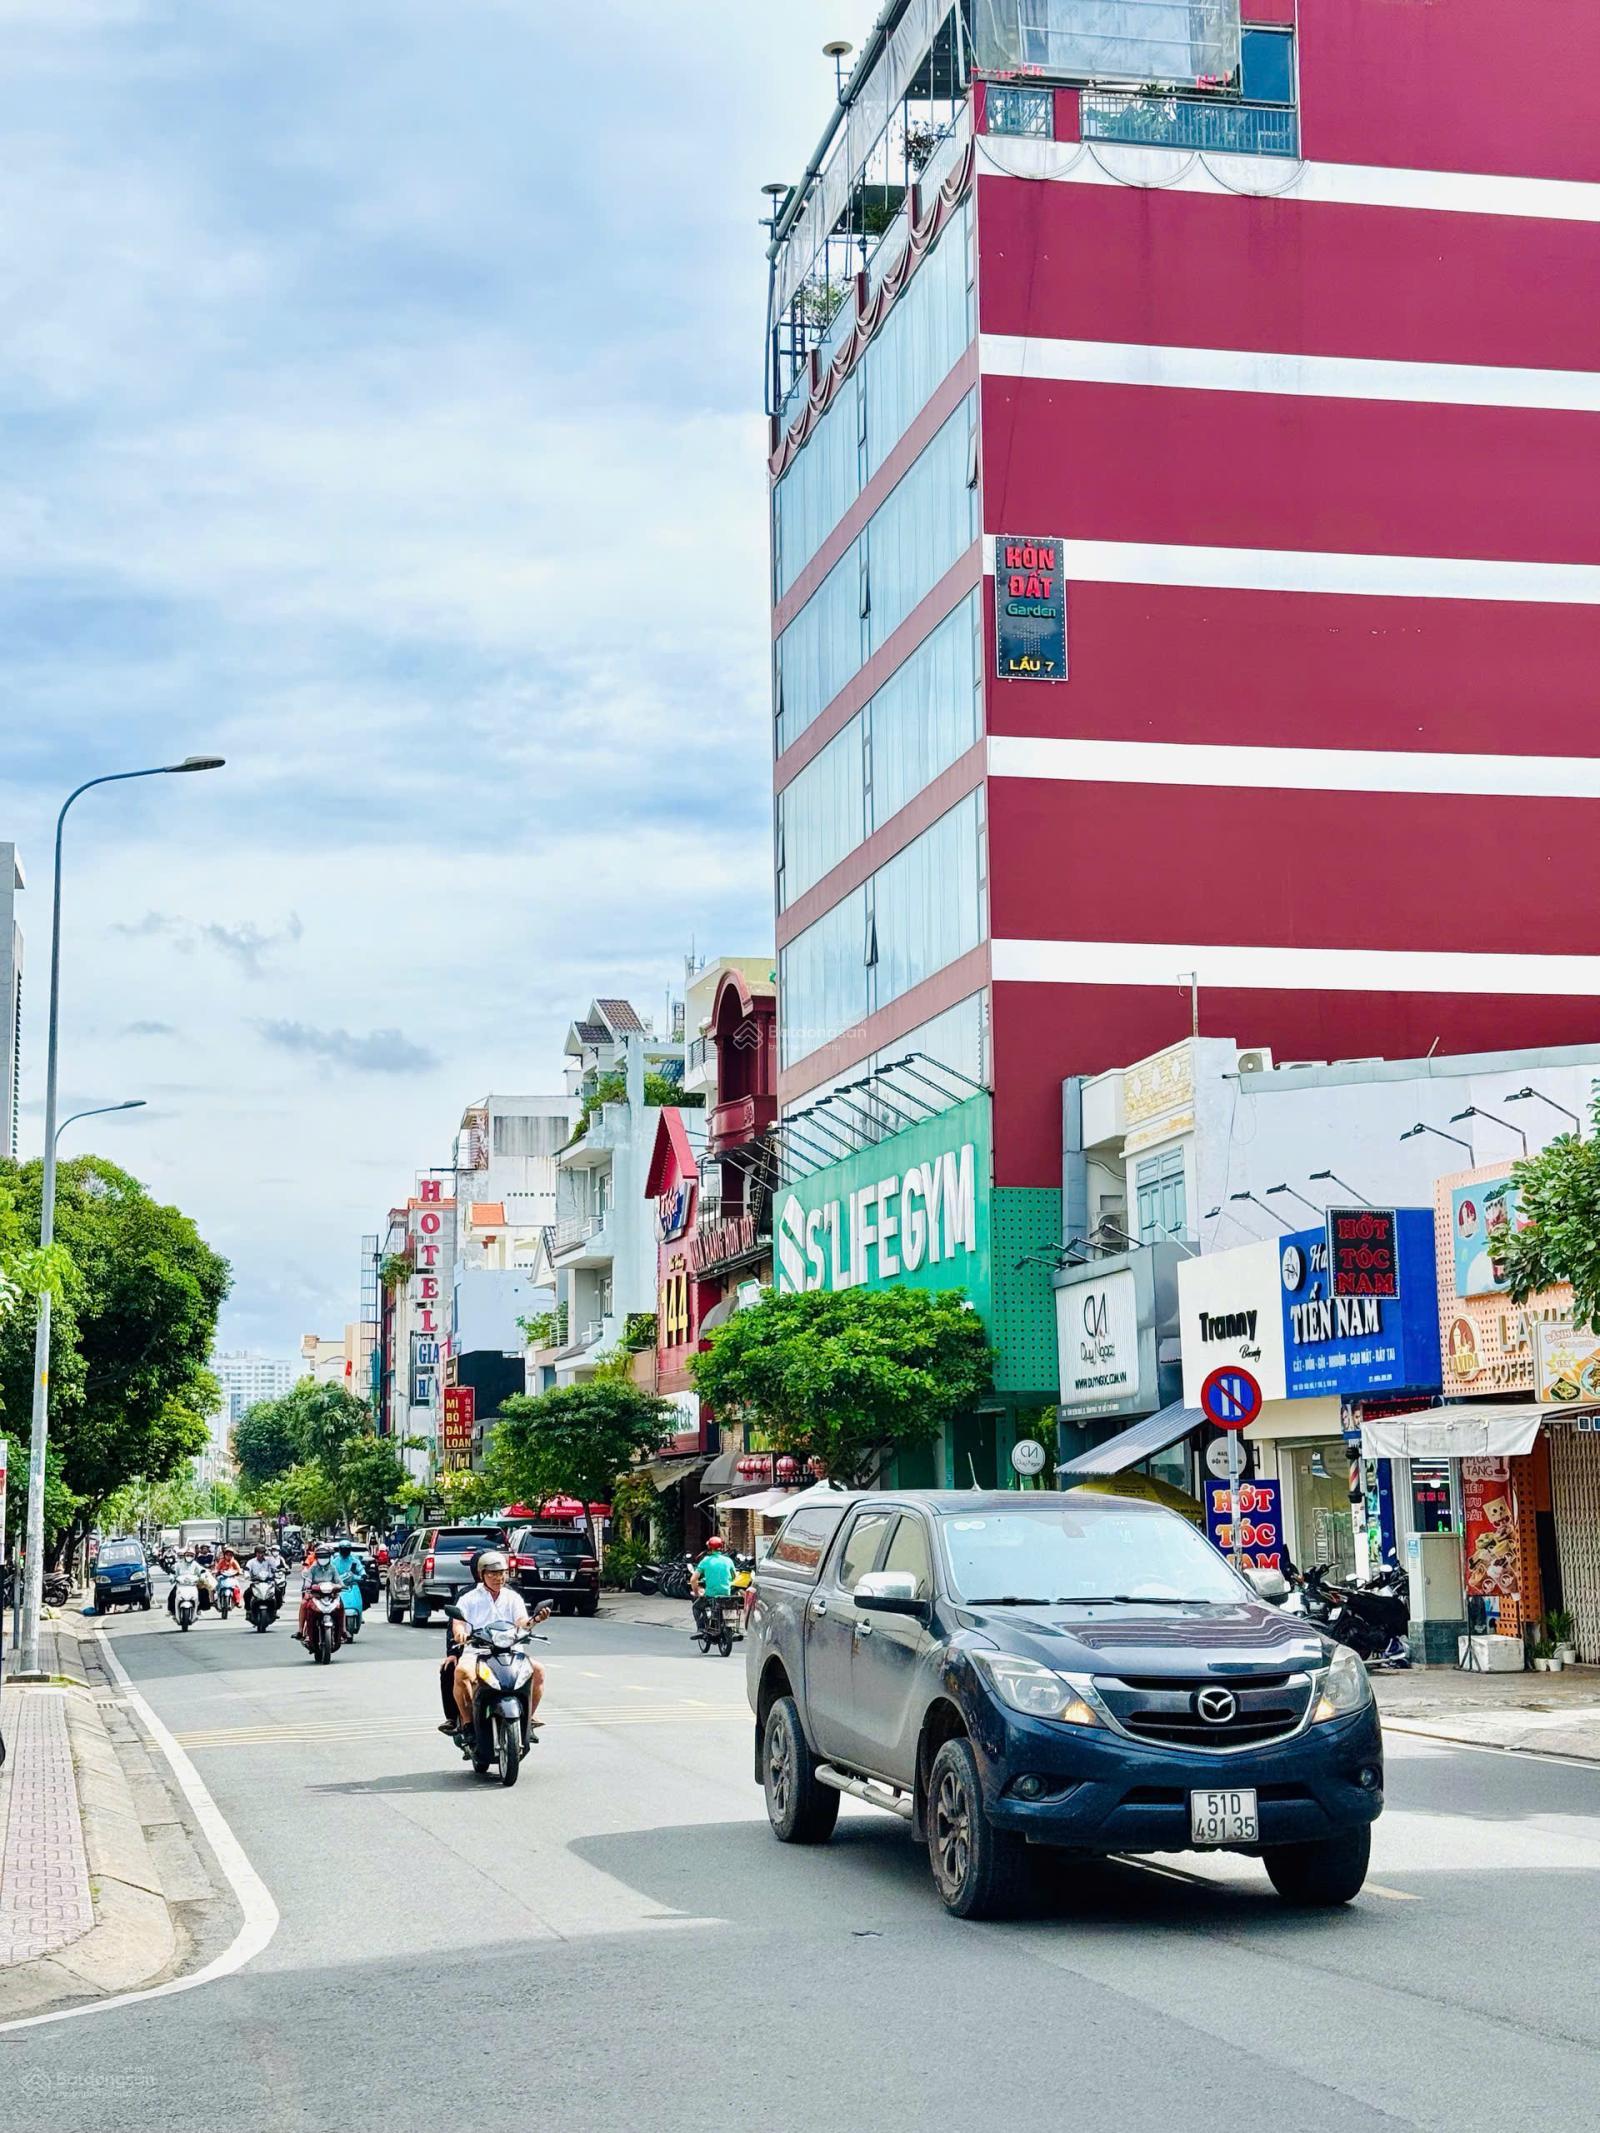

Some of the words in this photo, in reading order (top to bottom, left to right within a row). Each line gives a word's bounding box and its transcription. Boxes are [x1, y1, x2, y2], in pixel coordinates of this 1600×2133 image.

[1006, 542, 1054, 569] HÒN
[1008, 569, 1053, 599] ĐẤT
[1007, 603, 1056, 617] Garden
[1044, 661, 1055, 672] 7
[1338, 1214, 1390, 1240] HỚT
[420, 1180, 441, 1332] HOTEL
[1339, 1243, 1390, 1269] TÓC
[1338, 1272, 1394, 1294] NAM
[661, 1271, 688, 1349] 144
[1290, 1281, 1332, 1345] TIẾN
[1337, 1298, 1380, 1339] NAM
[1199, 1310, 1257, 1342] Tranny
[418, 1343, 440, 1365] GIA
[446, 1411, 460, 1422] BÒ
[446, 1438, 472, 1448] LOAN
[1213, 1484, 1274, 1514] HỚT
[1215, 1518, 1276, 1547] TÓC
[1208, 1794, 1241, 1815] 51D
